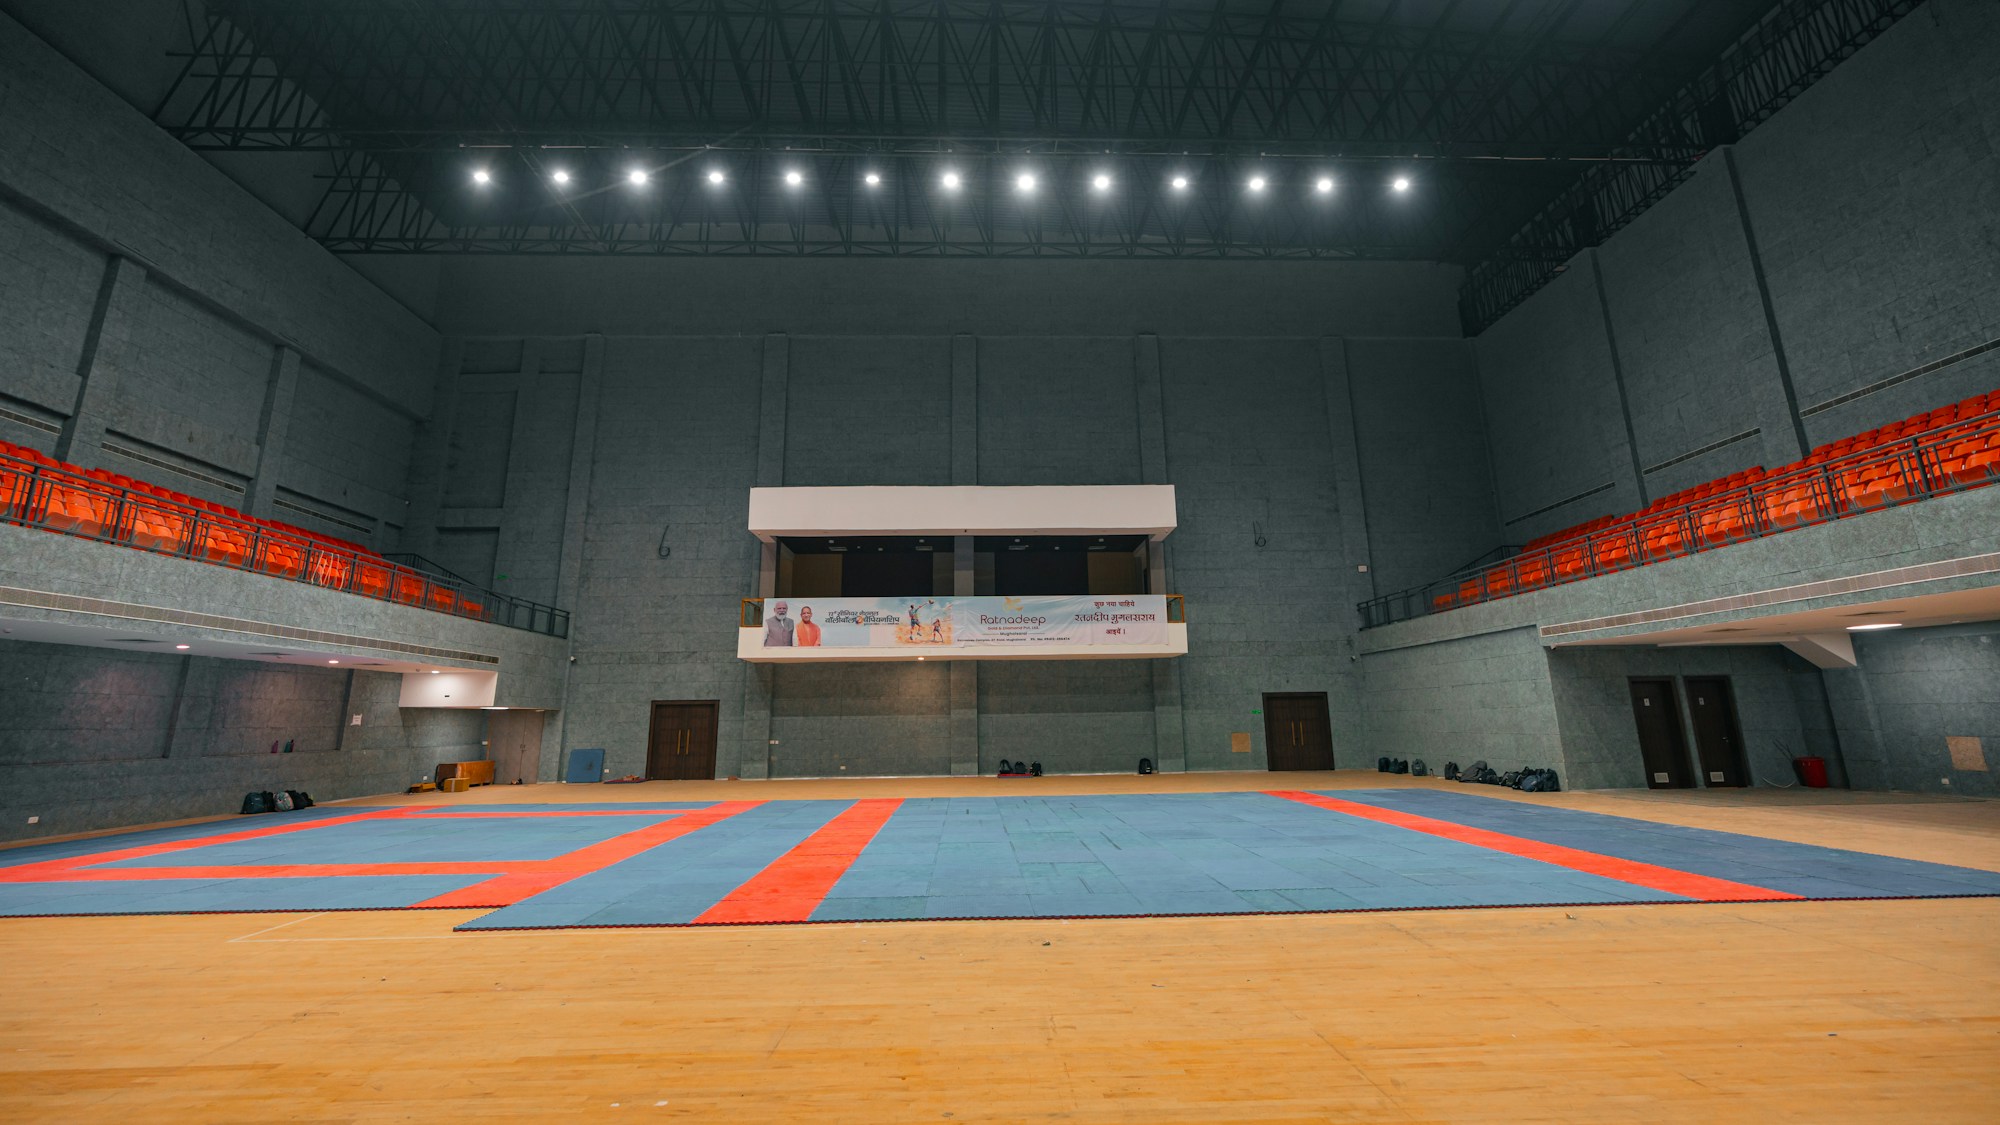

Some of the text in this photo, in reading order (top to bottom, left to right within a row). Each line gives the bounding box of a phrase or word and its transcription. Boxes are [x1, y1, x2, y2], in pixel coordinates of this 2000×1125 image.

[980, 614, 1046, 626] Ratnadeep
[1074, 611, 1155, 624] रतनदीप मुगलसराय
